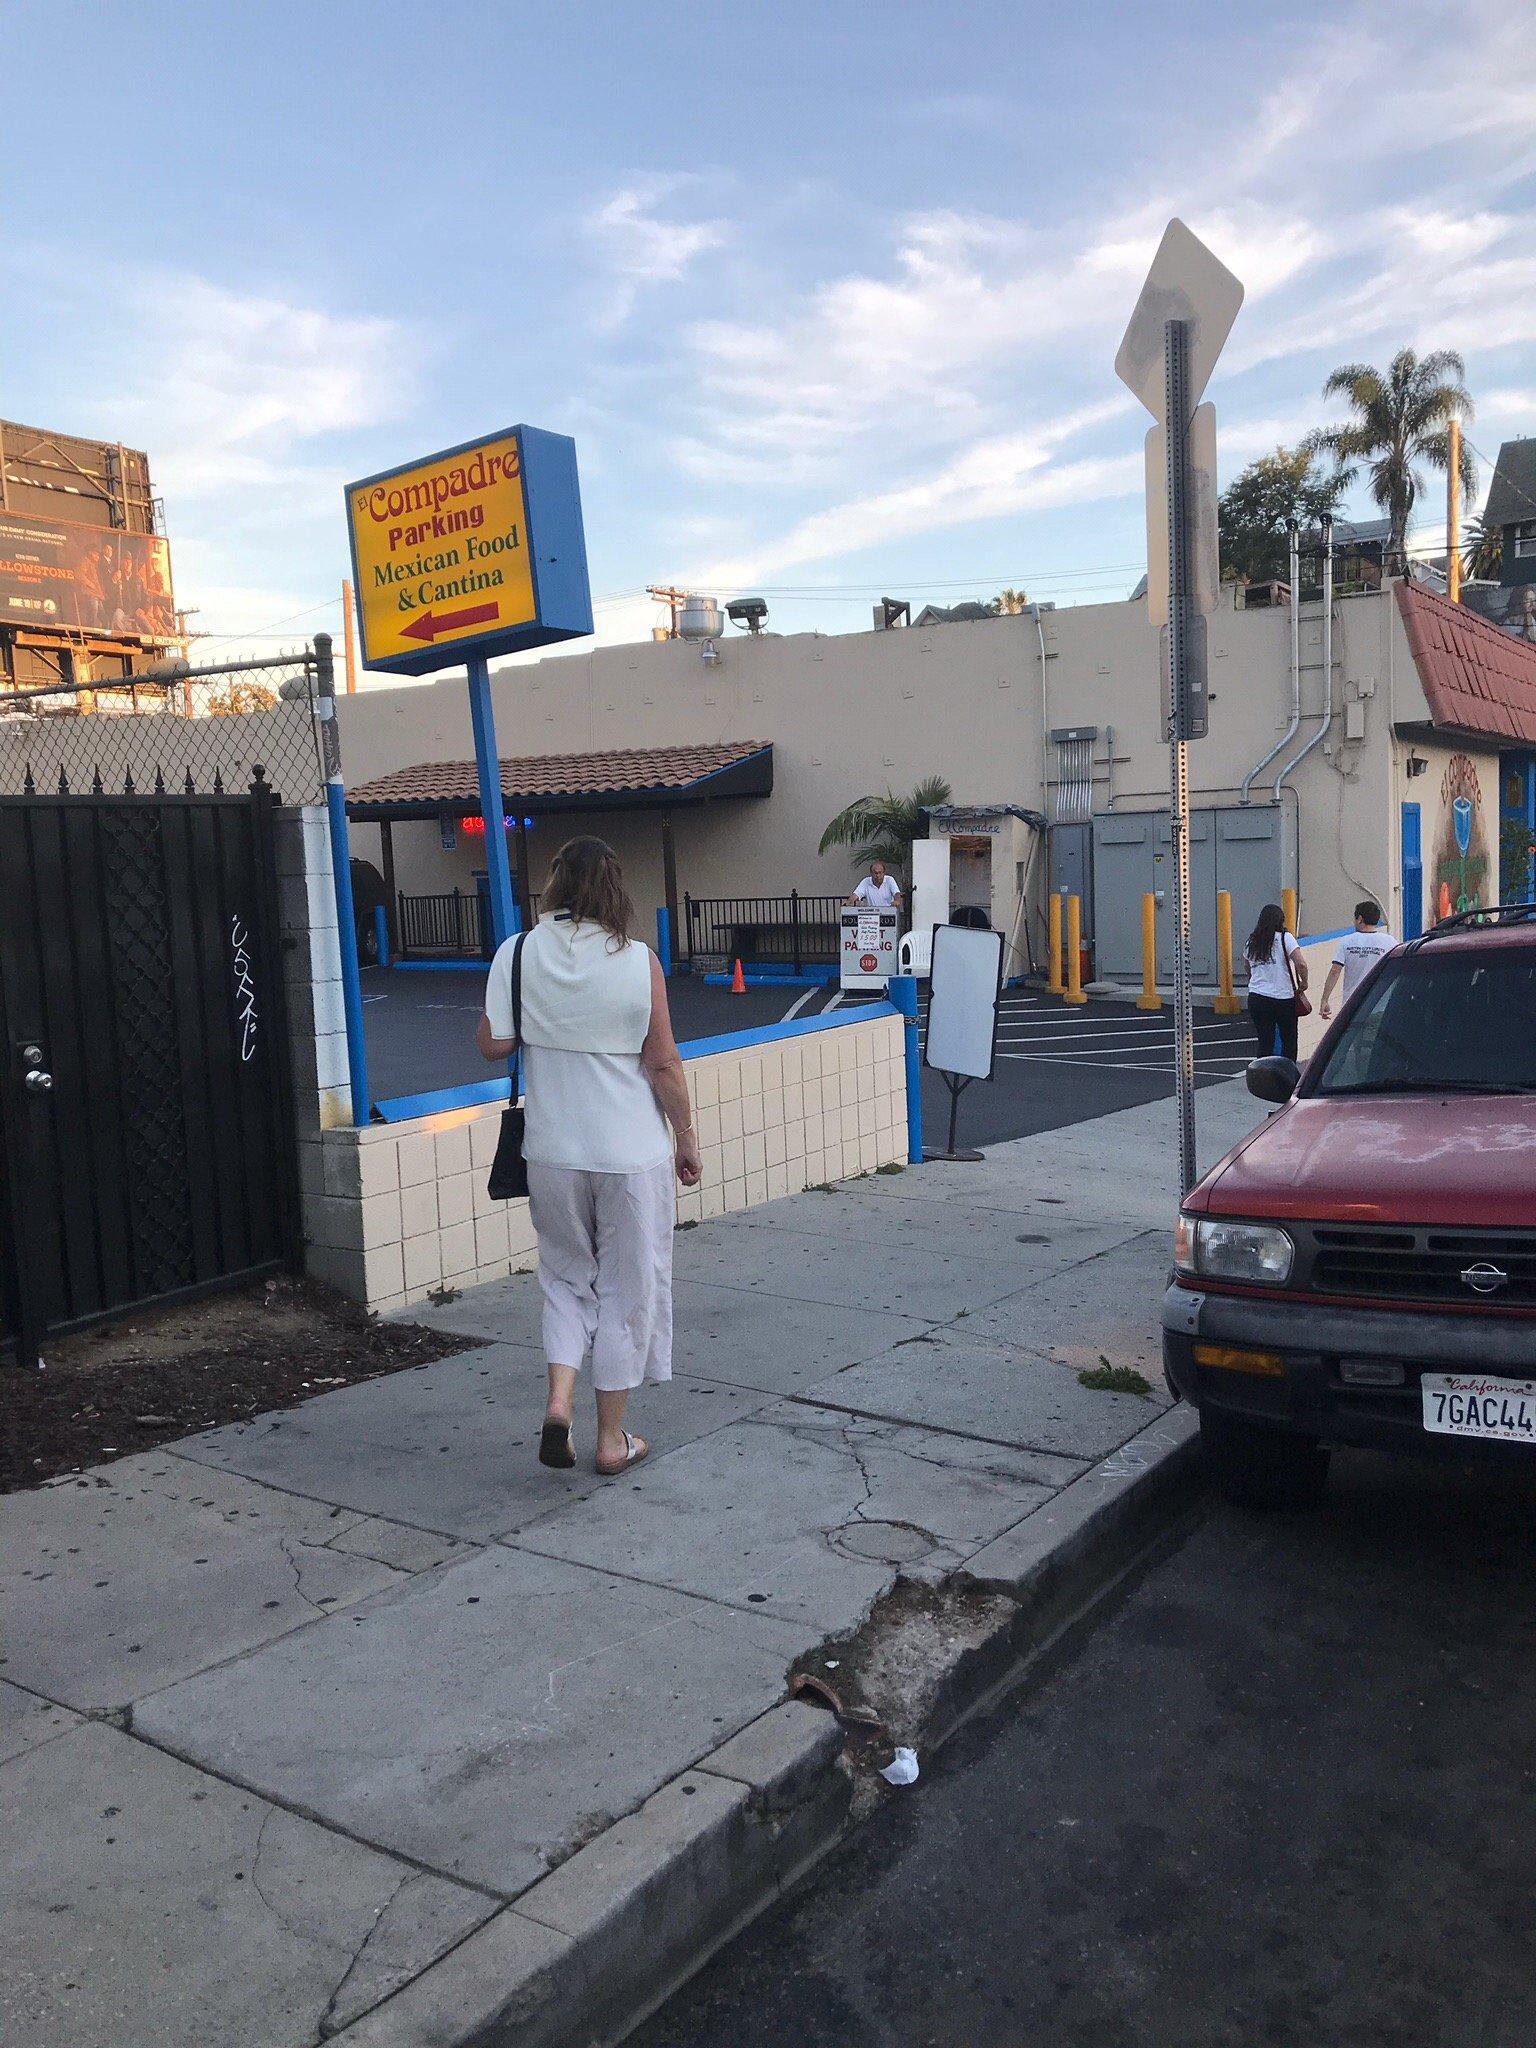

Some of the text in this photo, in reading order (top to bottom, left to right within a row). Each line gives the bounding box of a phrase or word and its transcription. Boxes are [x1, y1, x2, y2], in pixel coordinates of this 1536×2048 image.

[357, 450, 520, 522] El Compadre
[388, 504, 485, 551] Parking
[373, 523, 520, 588] Mexican Food
[418, 568, 504, 605] Cantina
[939, 819, 1001, 834] El Compadre
[844, 941, 893, 951] PANG
[1450, 1378, 1535, 1396] California
[1432, 1392, 1535, 1432] 7GAC44
[1456, 1426, 1525, 1437] dmv.ca.gov
